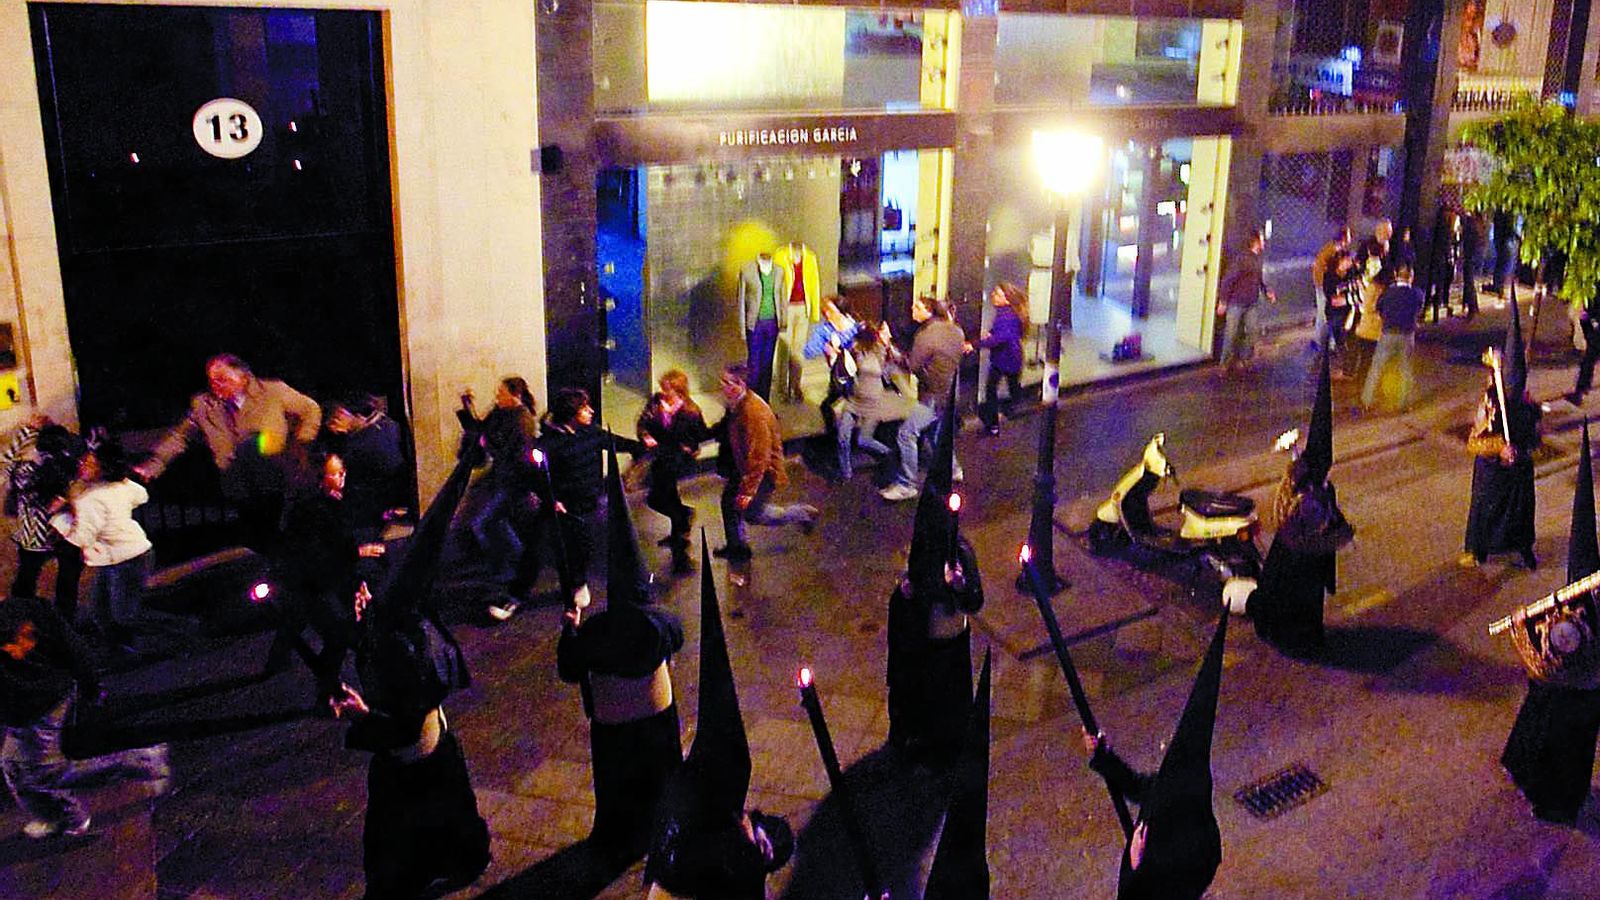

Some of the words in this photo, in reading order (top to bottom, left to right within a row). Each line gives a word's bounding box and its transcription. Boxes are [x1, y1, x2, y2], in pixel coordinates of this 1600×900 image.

[206, 113, 249, 143] 13
[719, 128, 809, 146] PURIFICACION
[813, 127, 858, 143] GARCIA
